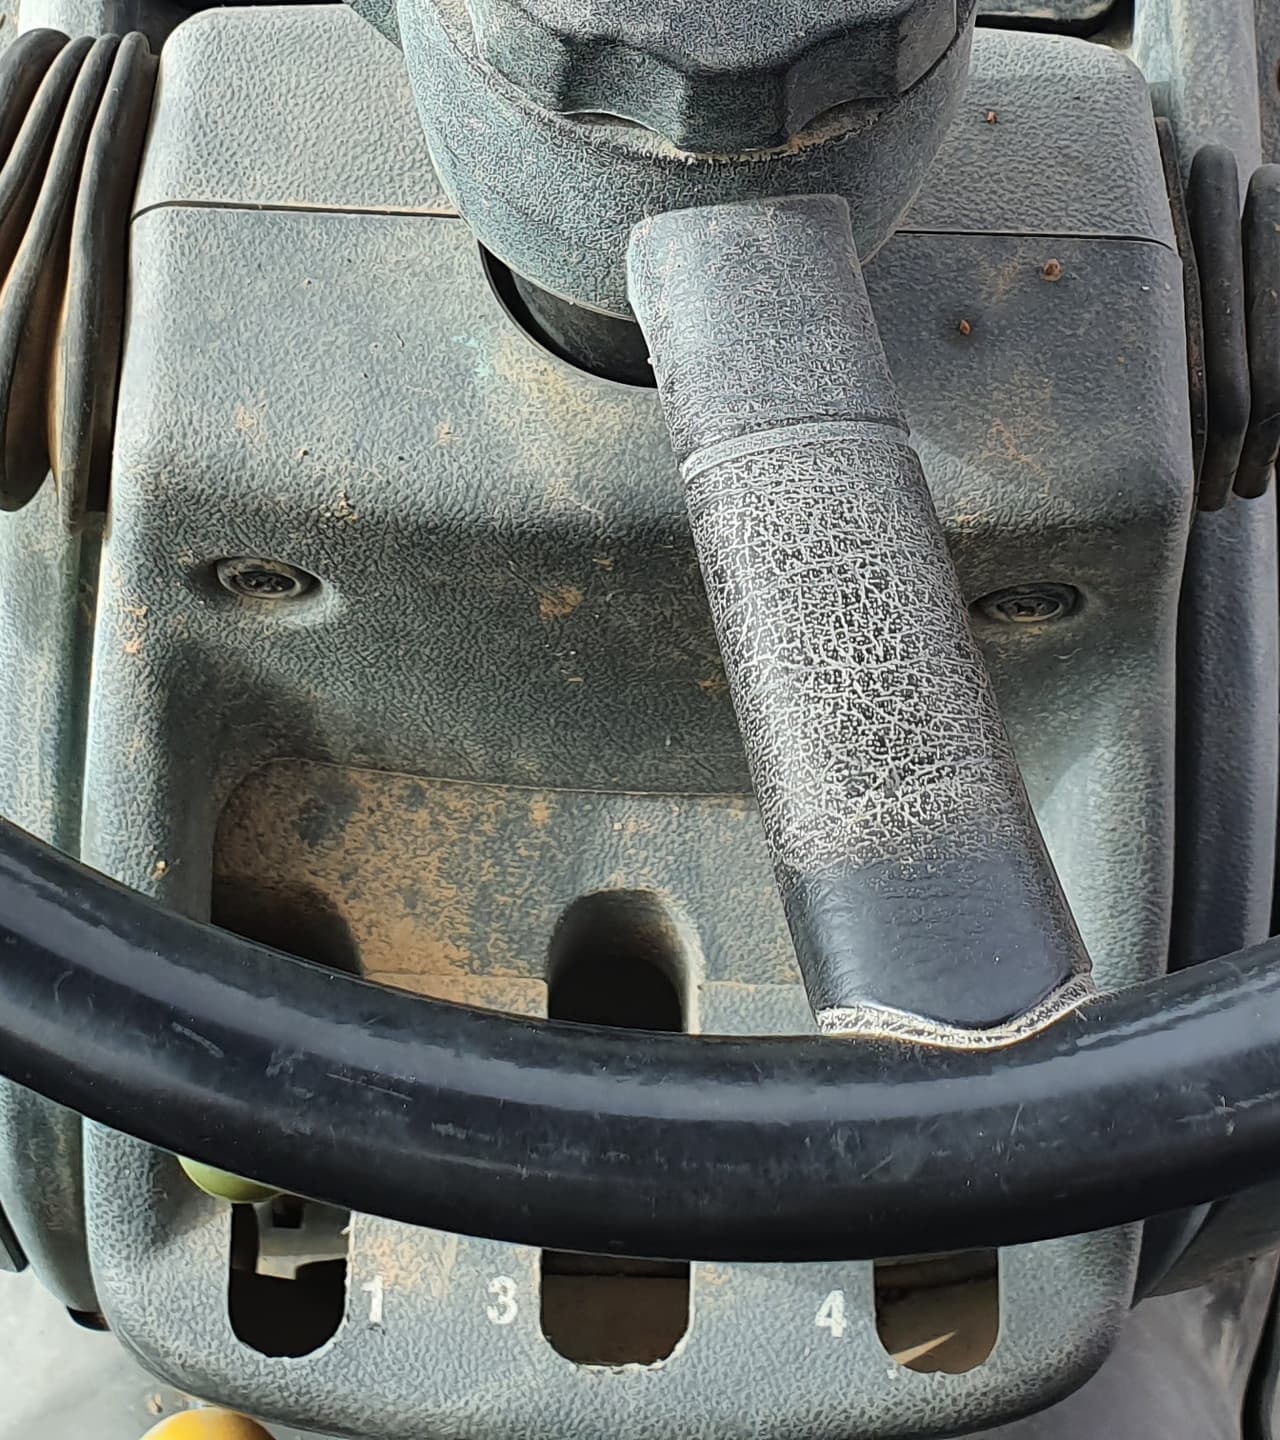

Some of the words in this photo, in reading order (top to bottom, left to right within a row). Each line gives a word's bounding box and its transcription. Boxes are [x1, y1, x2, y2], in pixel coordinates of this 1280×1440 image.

[361, 1276, 384, 1323] 1
[485, 1276, 519, 1325] 3
[814, 1289, 849, 1339] 4
